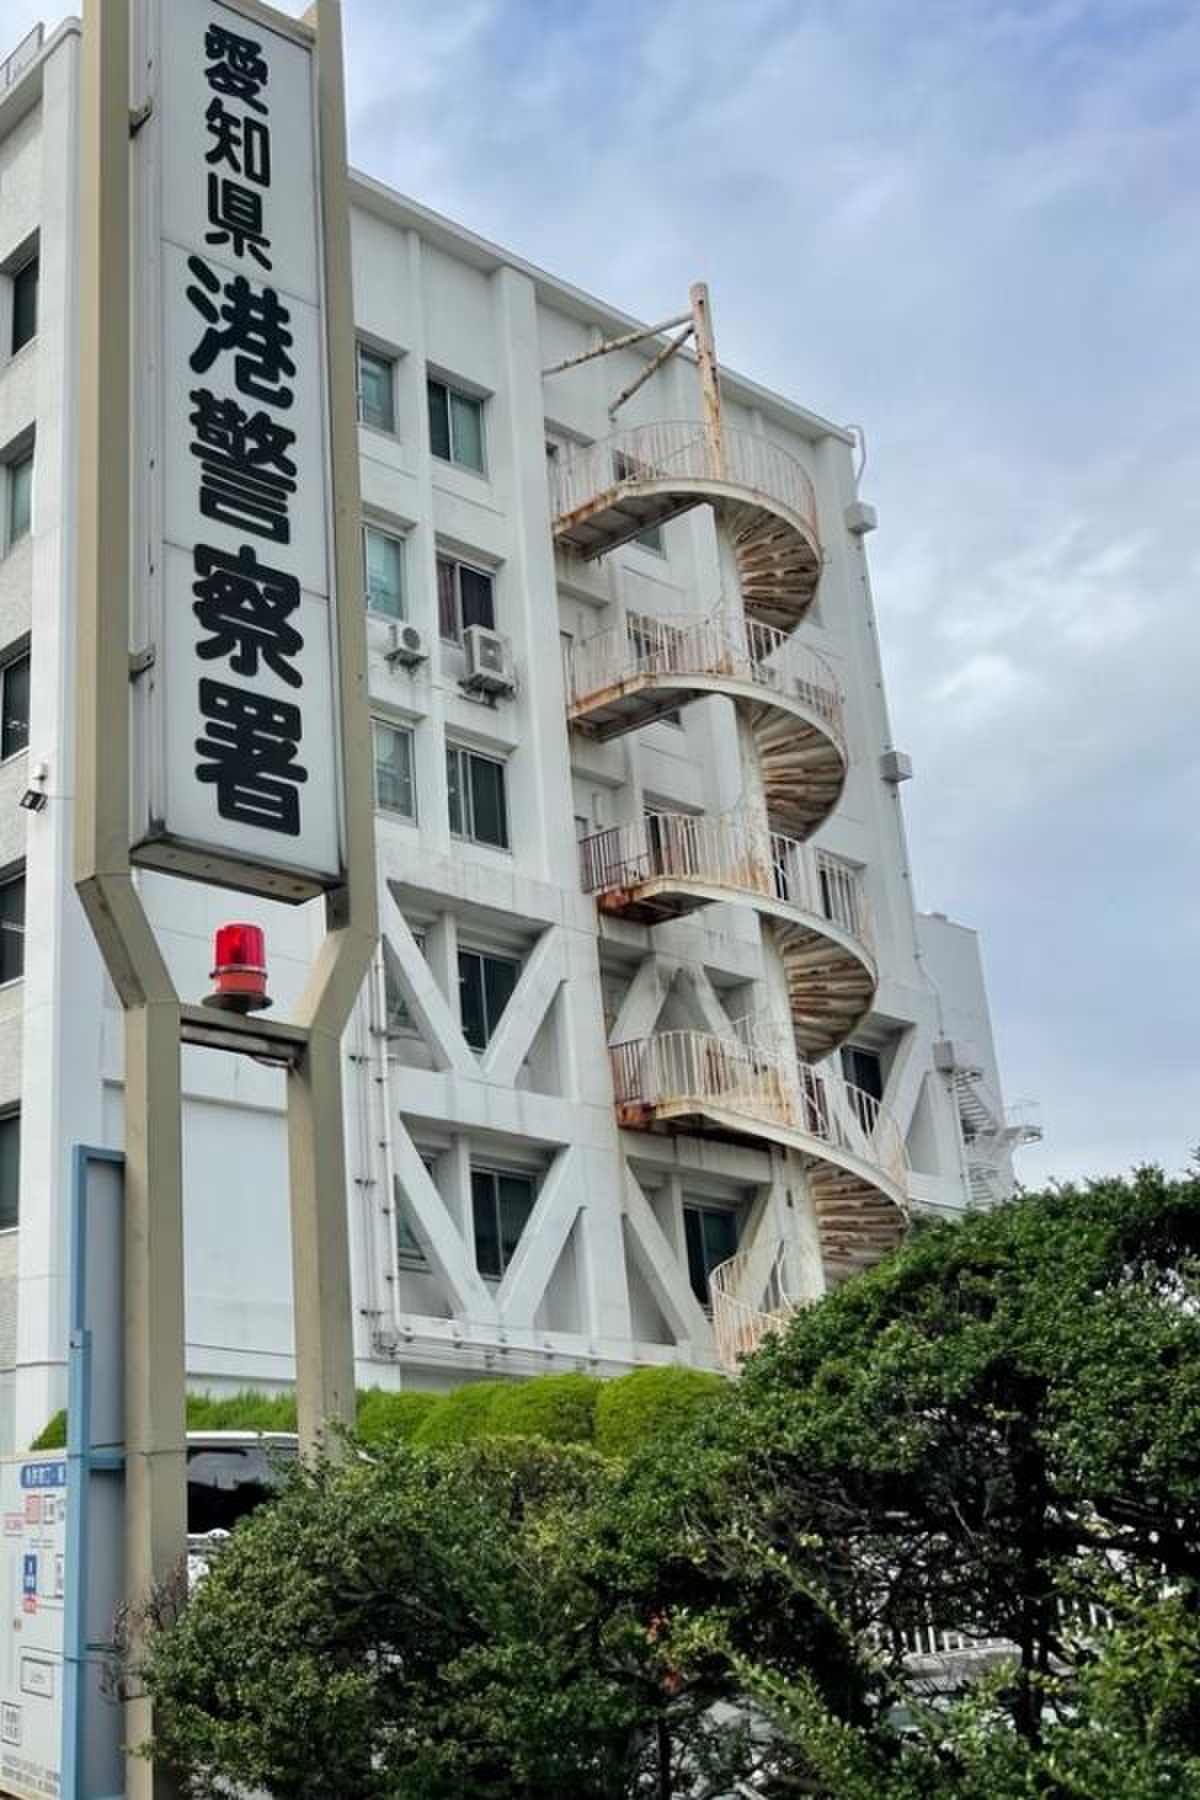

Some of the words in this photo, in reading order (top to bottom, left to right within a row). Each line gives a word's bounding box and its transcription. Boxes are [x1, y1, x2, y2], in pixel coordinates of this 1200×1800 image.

[187, 23, 308, 836] 愛知県港警察署
